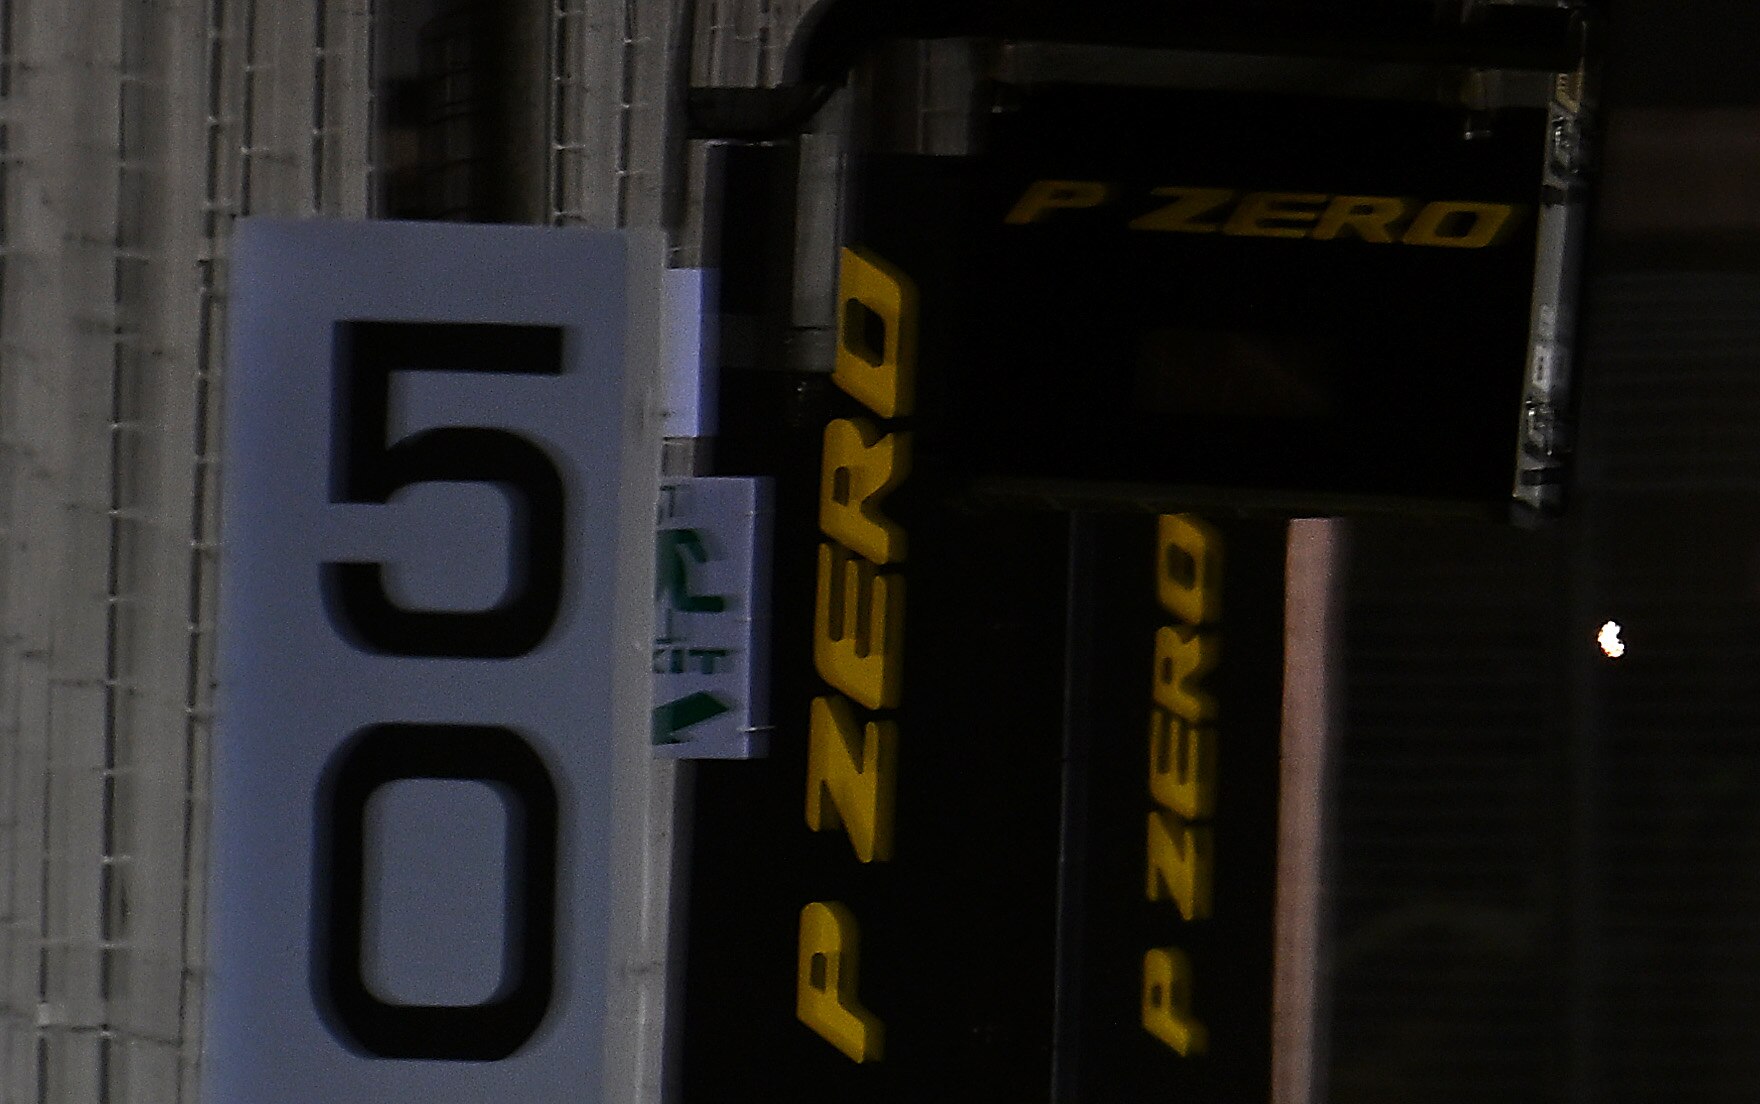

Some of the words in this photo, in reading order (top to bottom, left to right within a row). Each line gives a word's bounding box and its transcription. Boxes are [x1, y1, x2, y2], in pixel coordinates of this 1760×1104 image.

[1004, 179, 1112, 225] P
[1128, 186, 1516, 250] ZERO
[315, 318, 564, 1060] 50
[803, 244, 921, 864] ZERO
[1145, 511, 1224, 922] ZERO
[796, 900, 884, 1064] P
[1141, 947, 1210, 1058] P
